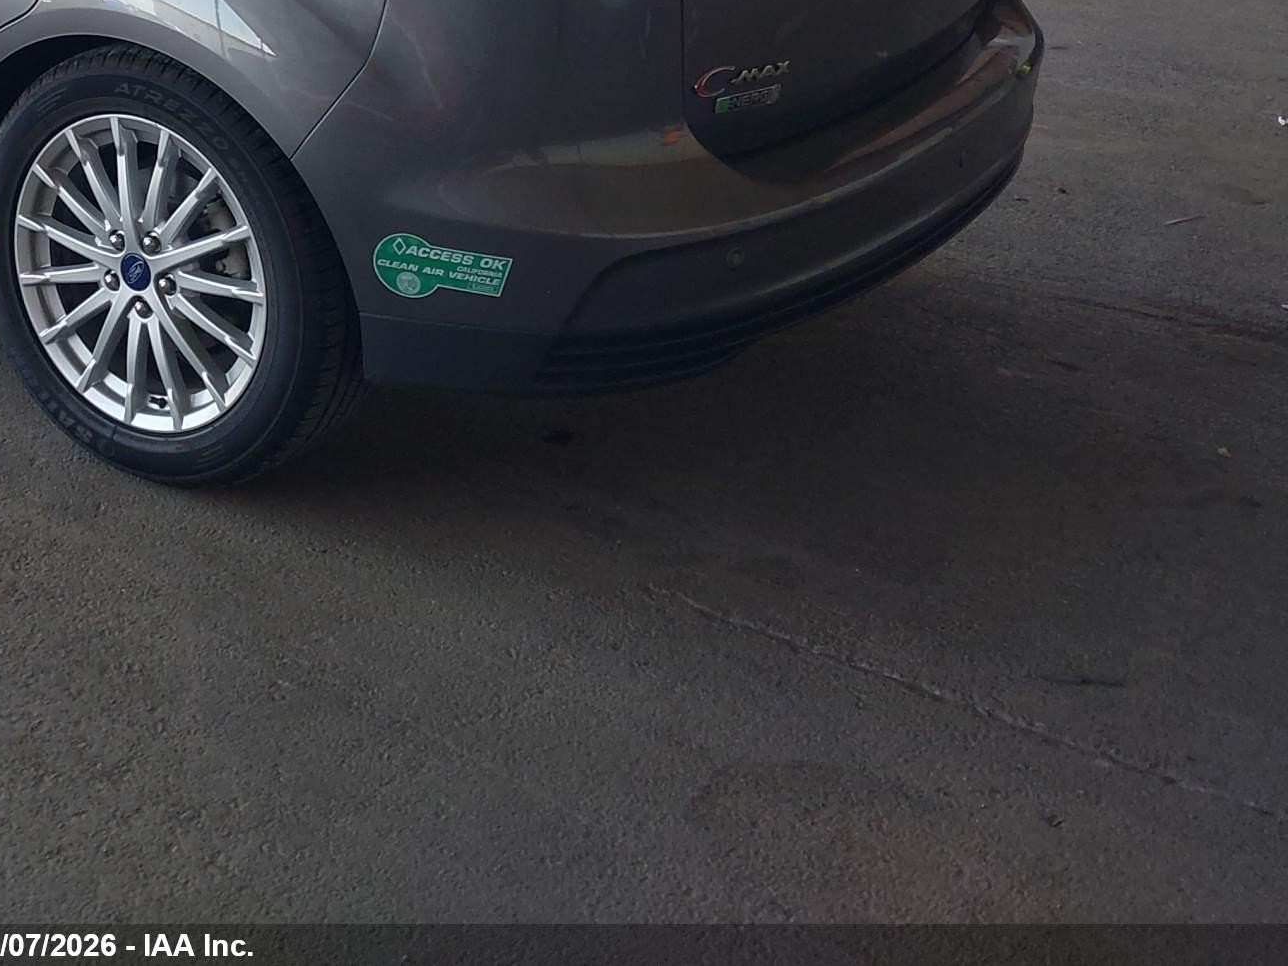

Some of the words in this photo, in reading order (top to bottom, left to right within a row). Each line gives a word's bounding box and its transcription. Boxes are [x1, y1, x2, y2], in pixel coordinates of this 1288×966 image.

[114, 81, 230, 152] ATREZZO
[377, 258, 419, 272] CLEAN
[422, 265, 445, 277] AIR
[448, 270, 502, 285] VEHICLE
[406, 246, 474, 265] ACCESS
[479, 257, 507, 271] OK
